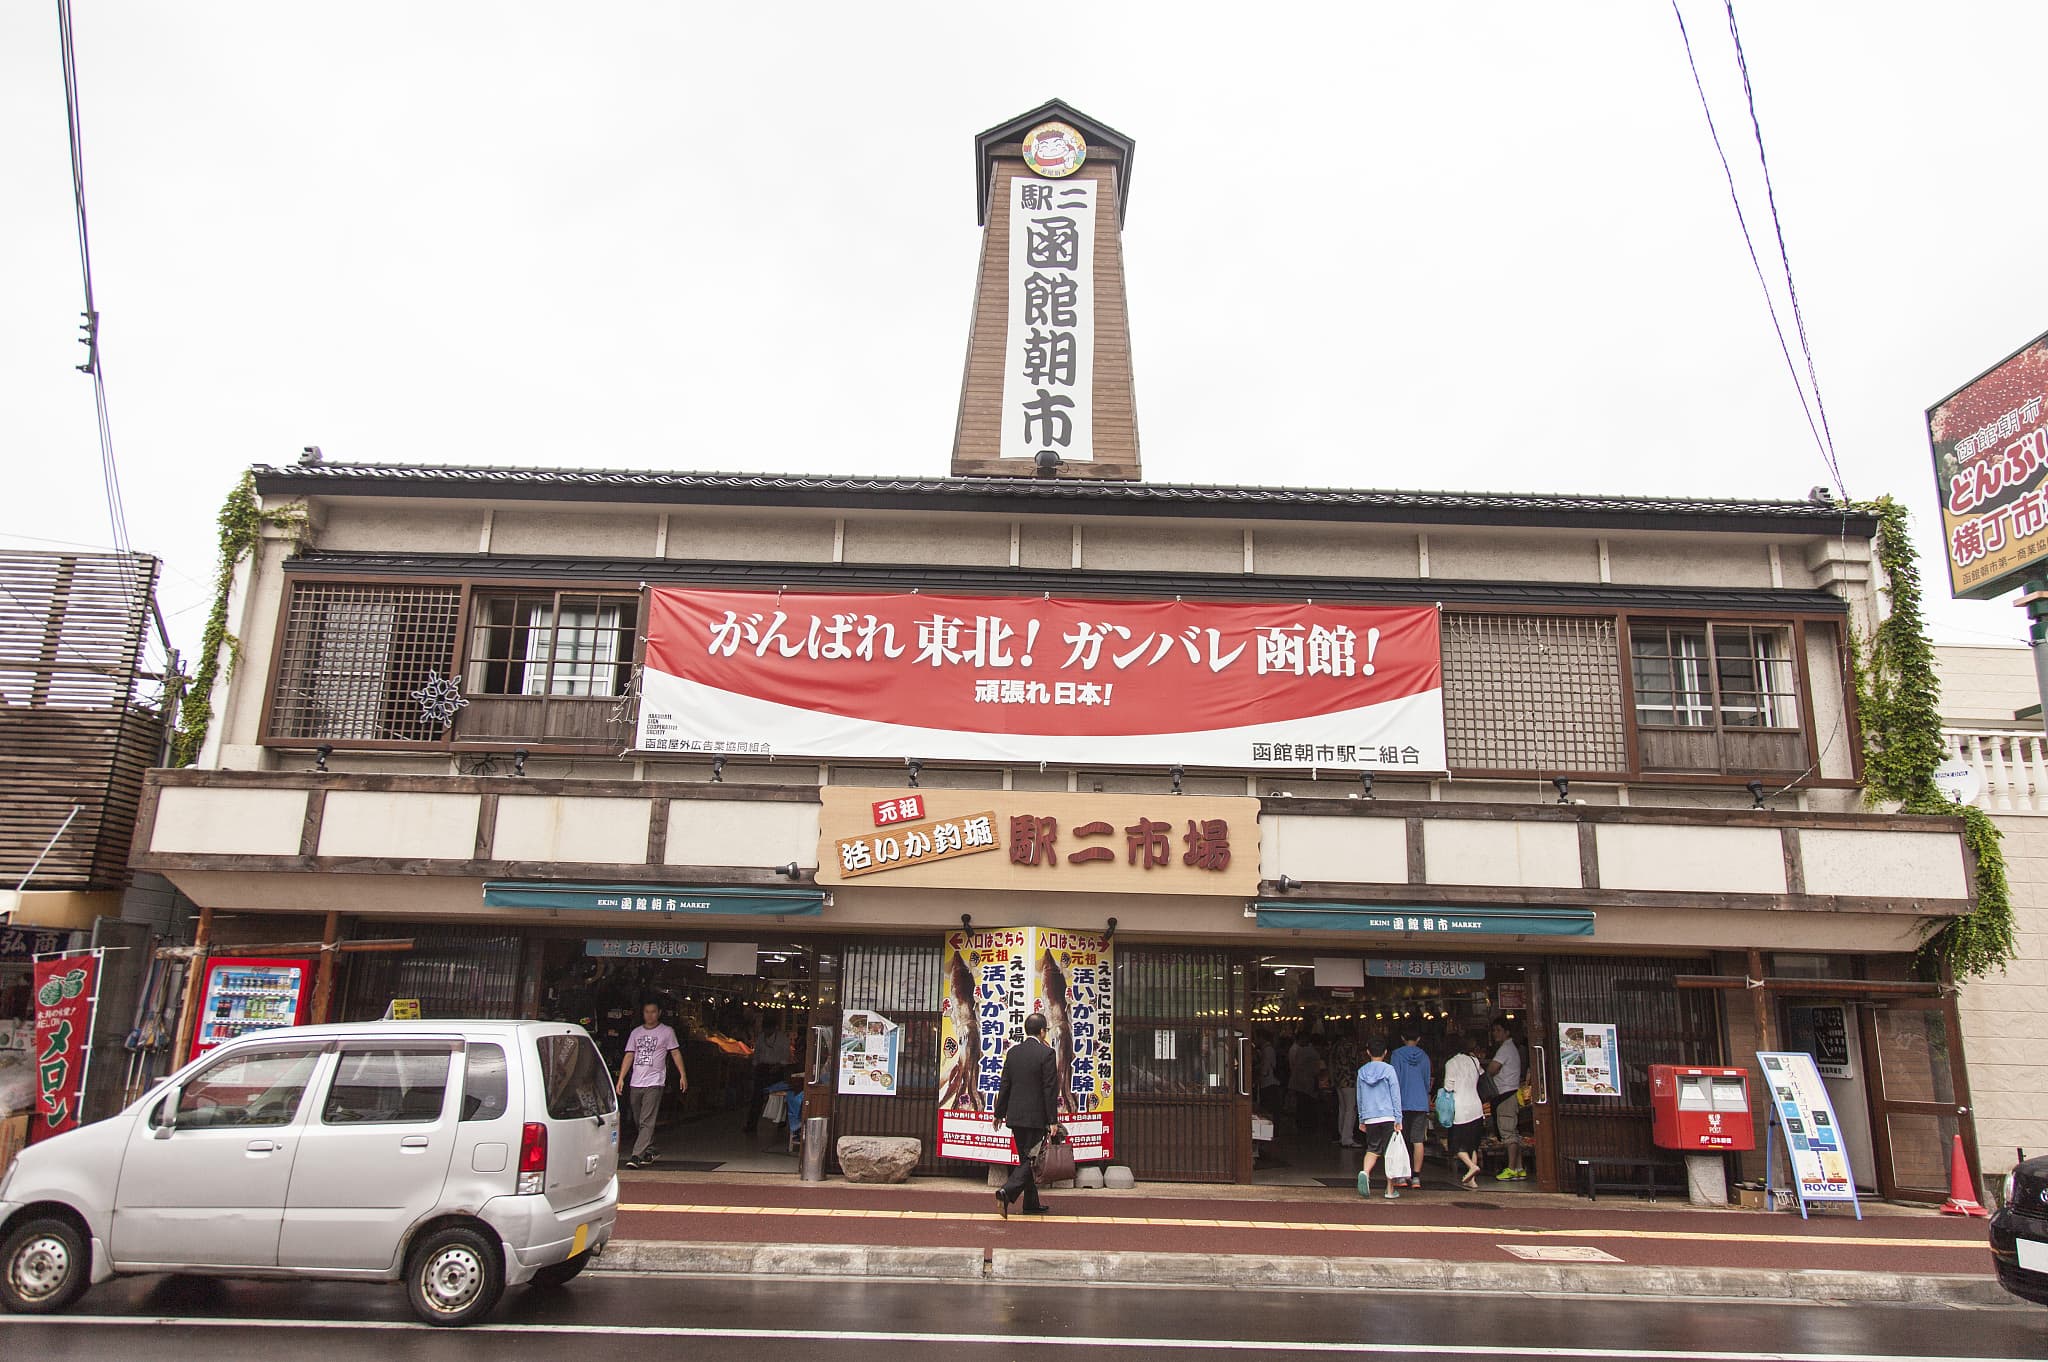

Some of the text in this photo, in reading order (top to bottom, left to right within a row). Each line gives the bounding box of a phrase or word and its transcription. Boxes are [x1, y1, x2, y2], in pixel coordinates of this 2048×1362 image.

[1021, 184, 1088, 211] 駅二
[1022, 216, 1080, 448] 函館朝市
[1954, 396, 2042, 464] 函館朝市
[1952, 484, 2048, 565] 横丁市
[1963, 535, 2048, 585] 函館朝市第一商業協
[708, 611, 1381, 677] がんばれ 東北! ガンバレ 函館!
[645, 738, 771, 753] 函館屋外広告業協同組合
[1252, 742, 1420, 765] 函館朝市駅二組合
[878, 797, 919, 822] 元祖
[841, 816, 993, 871] 活いか釣堀
[1009, 814, 1232, 873] 駅二市場
[621, 897, 676, 911] 函館朝市
[1393, 917, 1448, 931] 函館朝市
[626, 940, 689, 956] お手洗い
[965, 932, 1025, 950] 入口はこちら
[1040, 932, 1096, 951] 入口はこちら
[980, 950, 1009, 963] 元祖
[1071, 951, 1097, 965] 元祖
[1408, 960, 1471, 976] お手洗い
[1098, 960, 1112, 1079] えきに市場名物
[1071, 967, 1096, 1111] 活いか釣り体験!
[40, 1019, 73, 1128] メロン
